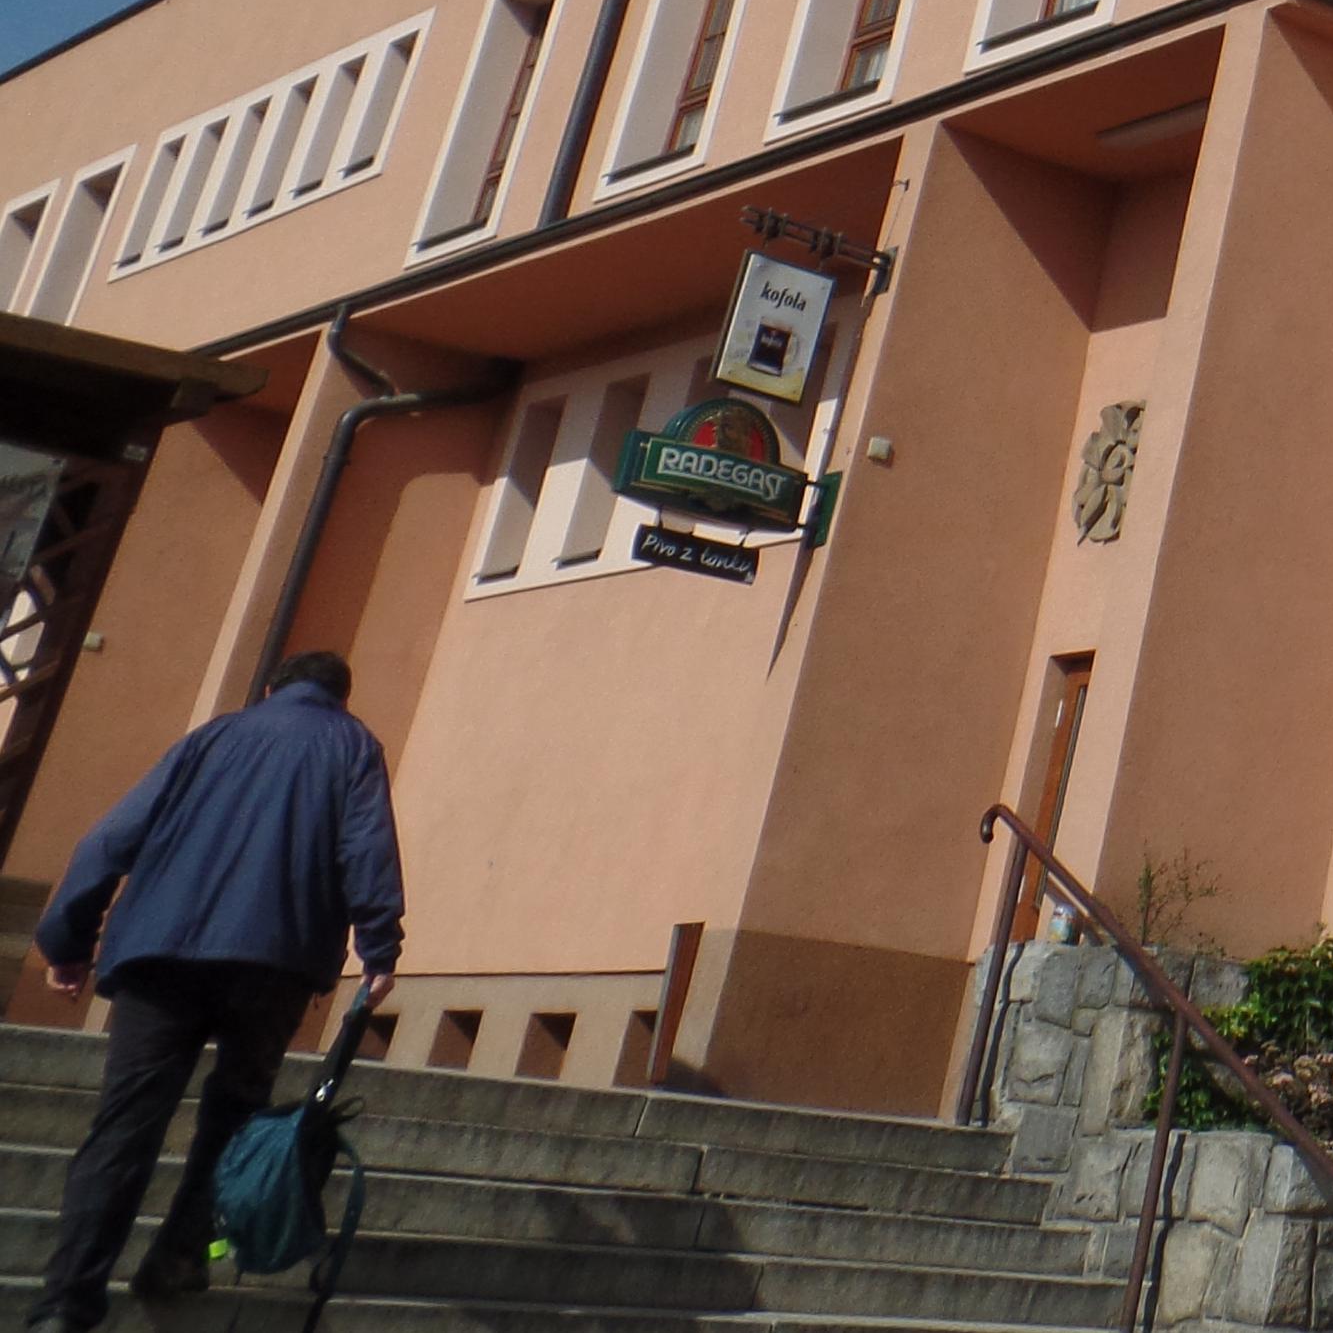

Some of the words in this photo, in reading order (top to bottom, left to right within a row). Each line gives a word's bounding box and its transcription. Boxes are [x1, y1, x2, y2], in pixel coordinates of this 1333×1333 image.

[760, 280, 807, 312] kofola
[658, 447, 786, 501] RADEGAST
[641, 533, 676, 557] Pivo
